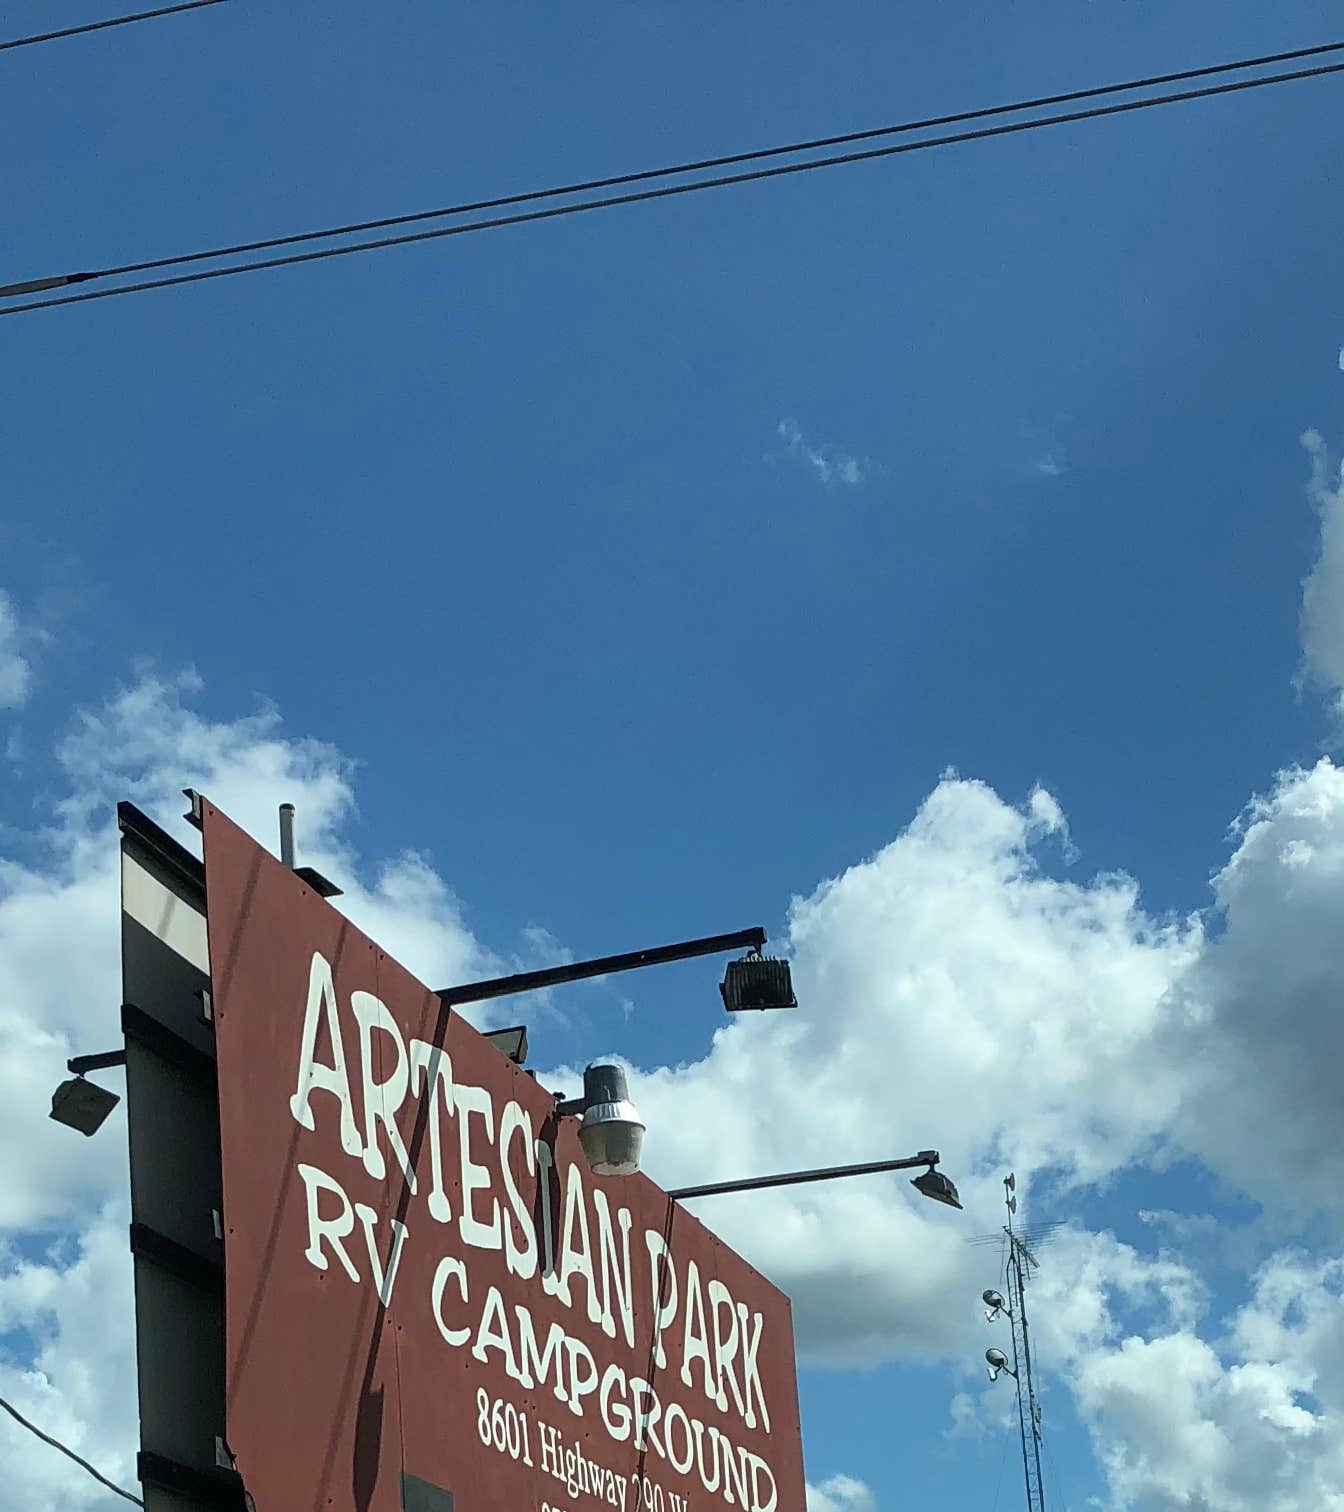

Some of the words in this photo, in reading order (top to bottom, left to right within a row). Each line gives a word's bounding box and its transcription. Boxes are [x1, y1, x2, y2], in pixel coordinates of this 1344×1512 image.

[289, 951, 636, 1349] ARTESIAN
[646, 1229, 770, 1434] PARK
[297, 1163, 408, 1308] RV
[477, 1387, 534, 1467] 8601
